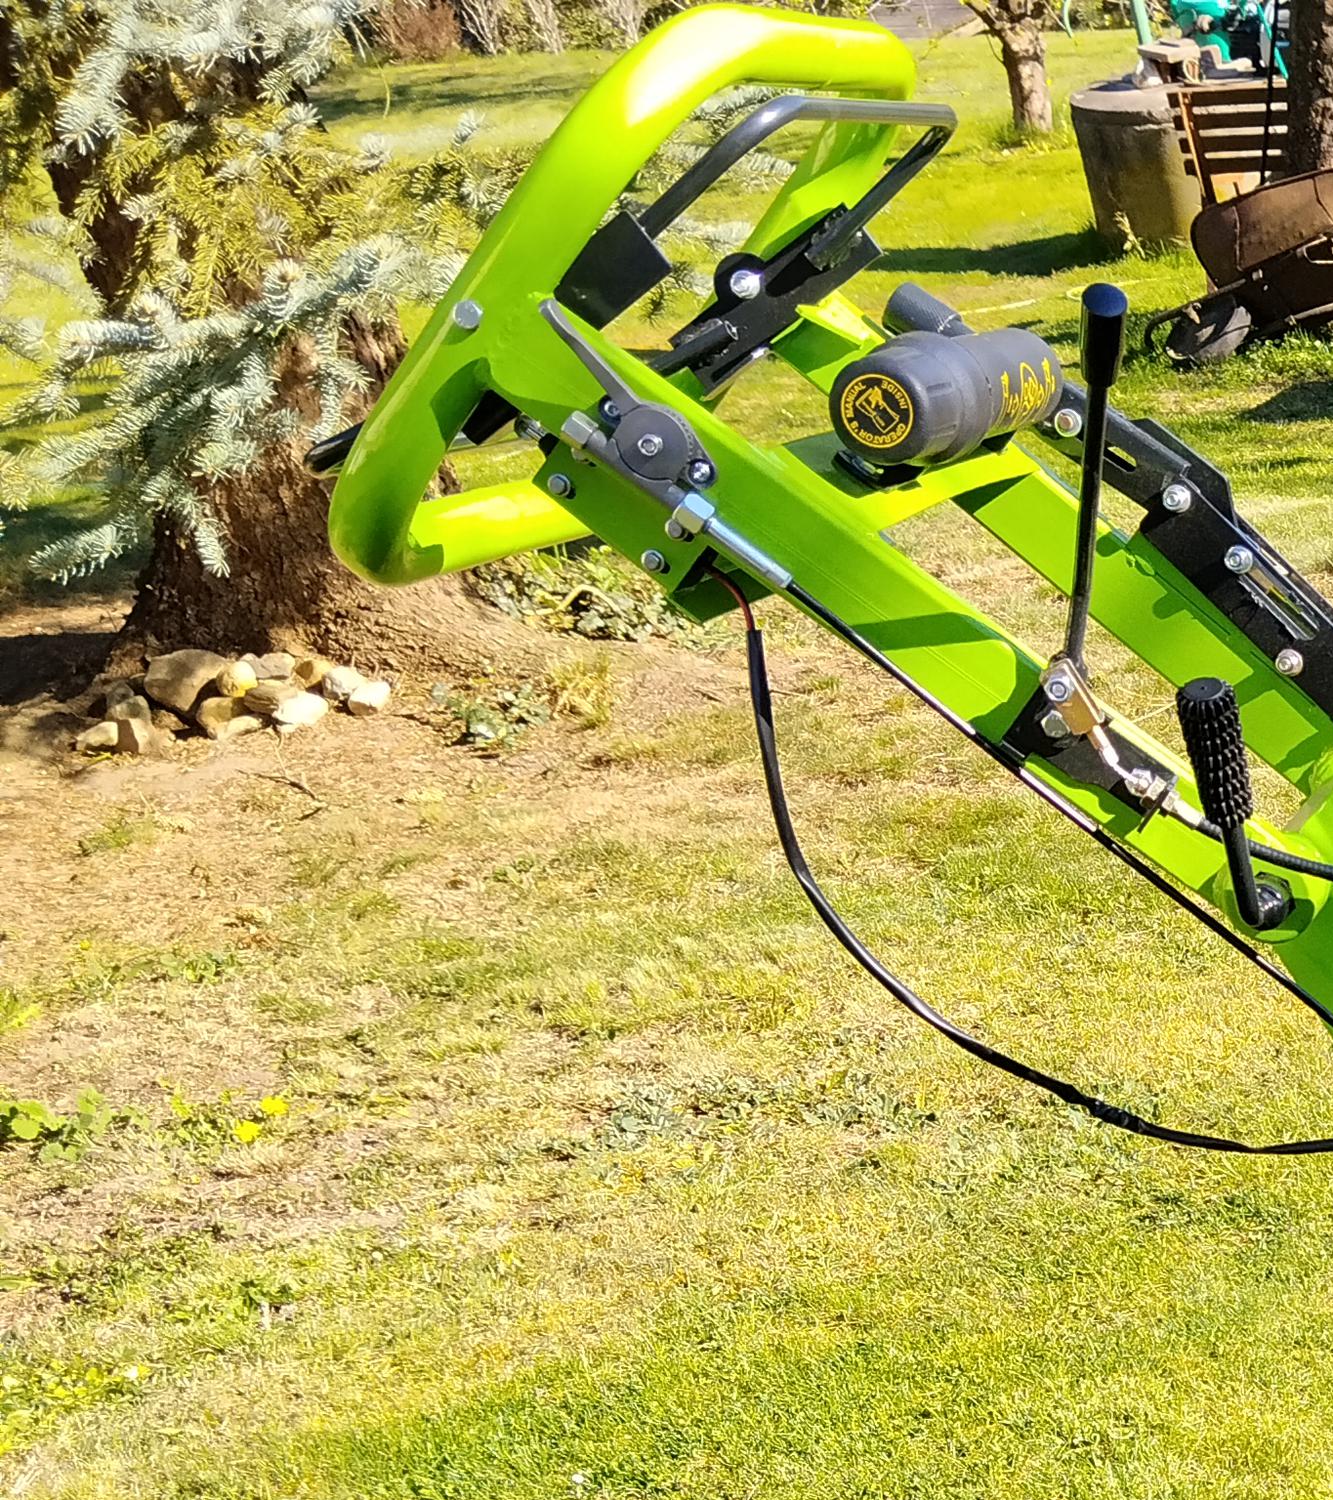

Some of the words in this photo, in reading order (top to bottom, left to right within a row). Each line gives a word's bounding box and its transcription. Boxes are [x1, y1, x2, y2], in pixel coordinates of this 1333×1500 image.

[844, 382, 867, 418] MANUAL
[881, 380, 908, 409] INSIDE
[850, 421, 906, 444] OPERATOR'S
